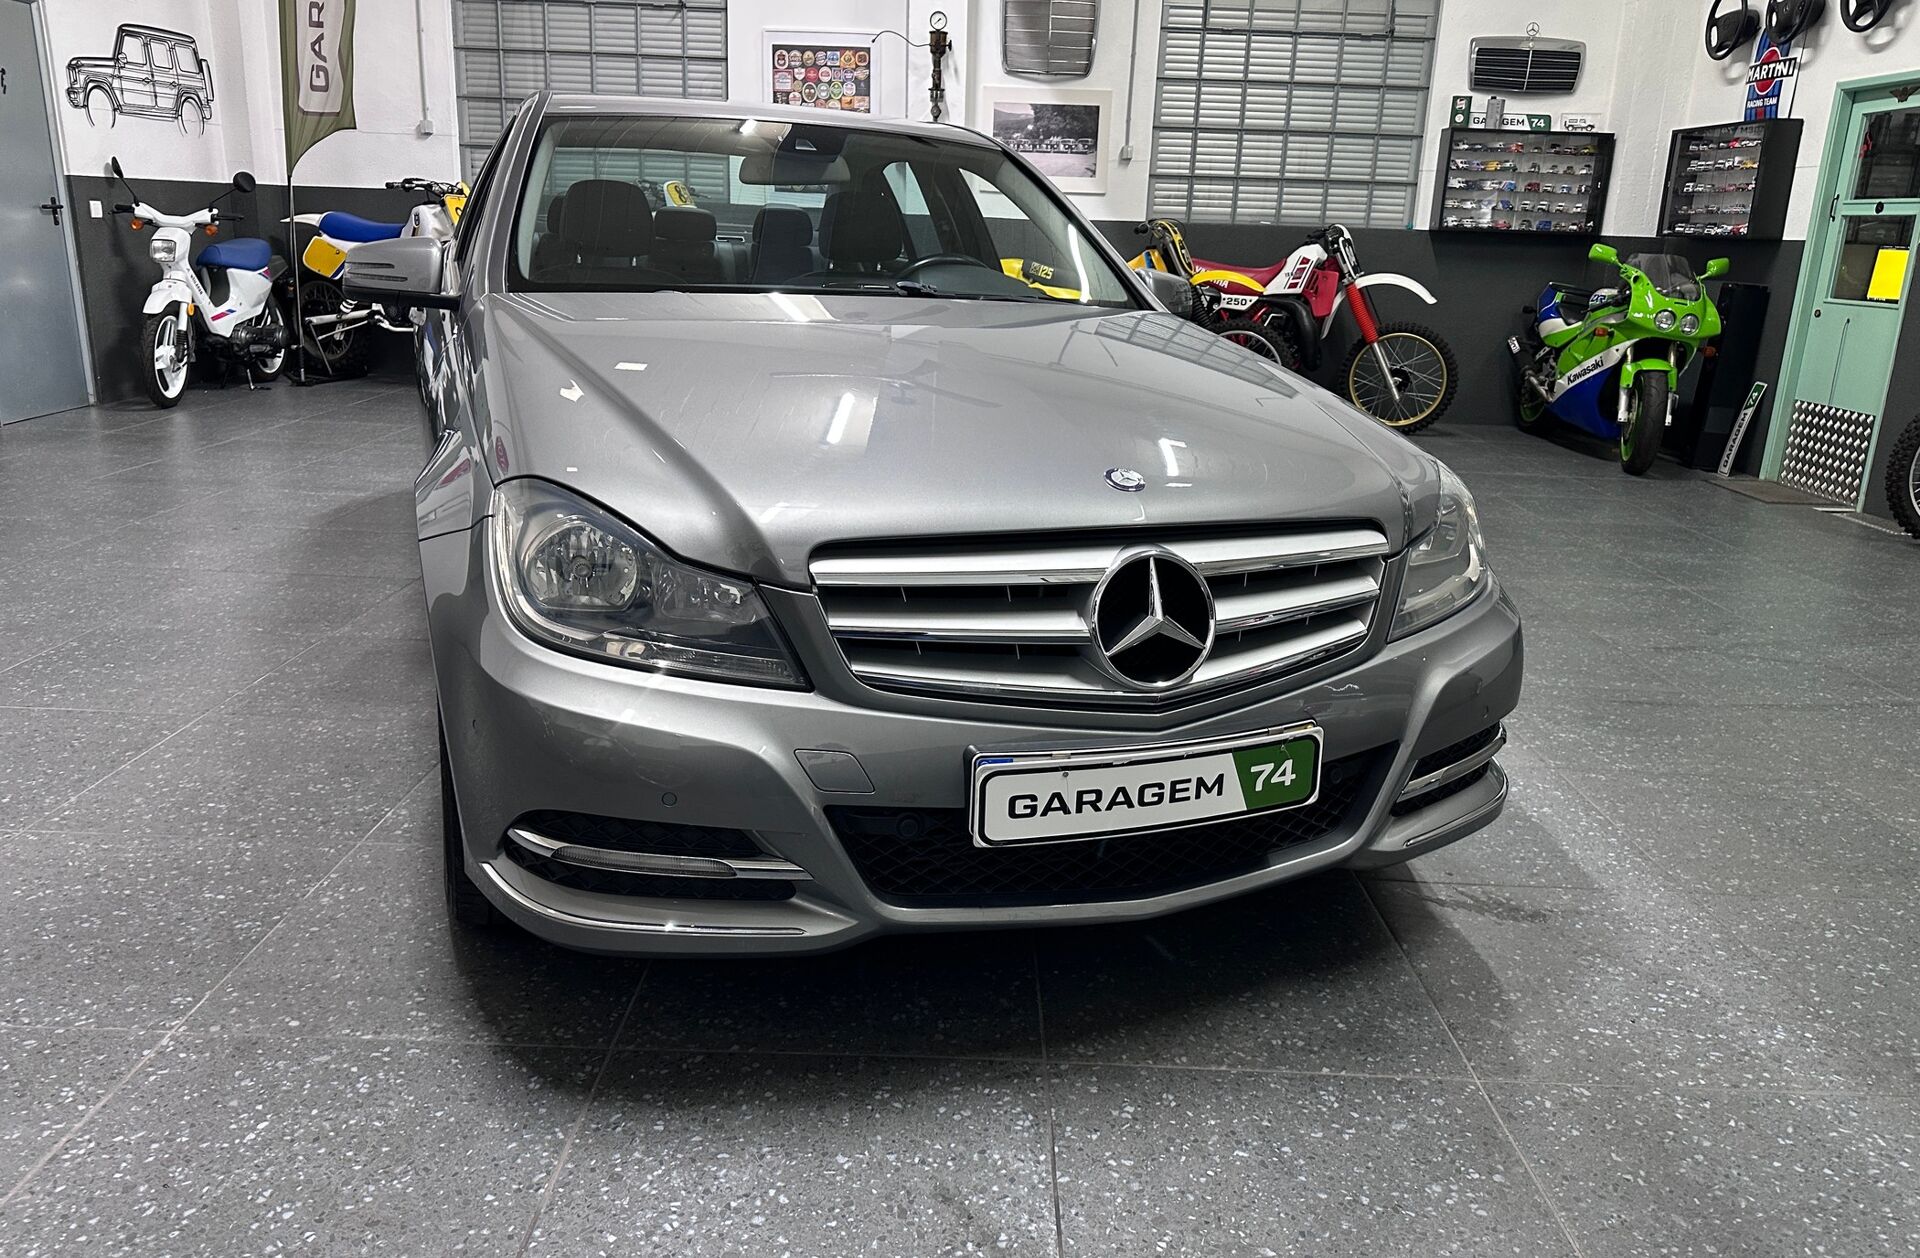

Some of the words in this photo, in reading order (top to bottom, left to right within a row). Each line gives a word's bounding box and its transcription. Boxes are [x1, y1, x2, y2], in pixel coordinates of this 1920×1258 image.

[1747, 60, 1795, 82] MARTINI
[1747, 98, 1763, 108] RACING
[1764, 96, 1778, 106] TEAM
[1473, 116, 1524, 126] GAGEM
[1530, 118, 1545, 128] 74
[1039, 264, 1054, 280] 125
[1226, 297, 1247, 306] 250
[1567, 356, 1604, 386] Kawasaki
[1722, 412, 1748, 468] GARAGEM
[1747, 391, 1759, 407] 74
[1007, 773, 1225, 819] GARAGEM
[1250, 759, 1297, 792] 74
